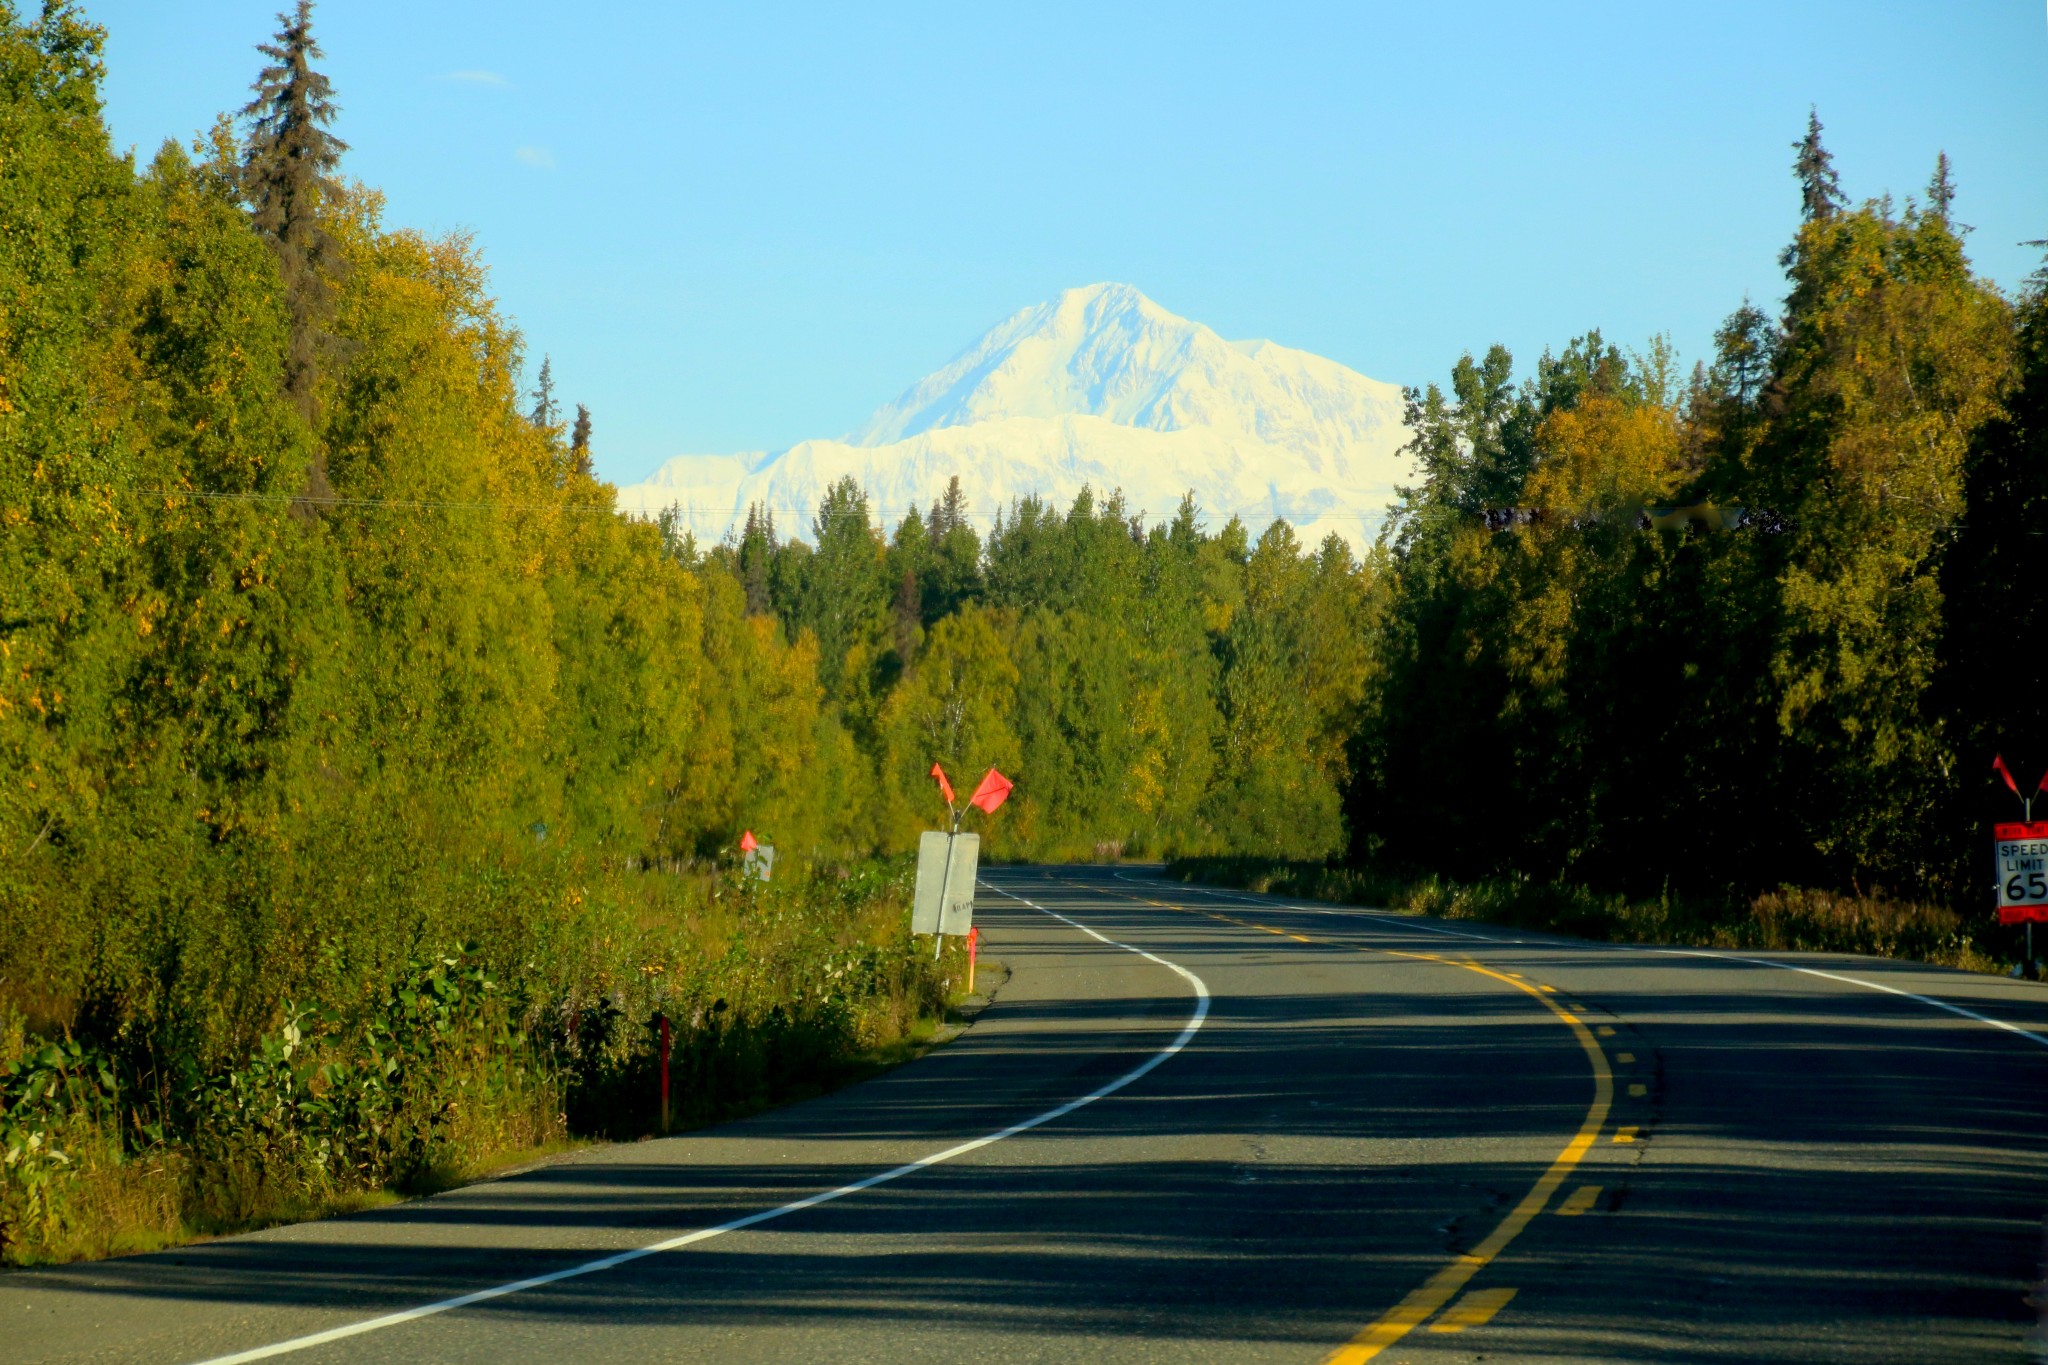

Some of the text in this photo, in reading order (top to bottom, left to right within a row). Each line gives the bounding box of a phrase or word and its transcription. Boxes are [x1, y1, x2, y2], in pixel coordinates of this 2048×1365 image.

[2001, 844, 2048, 857] SPEED
[2007, 859, 2044, 871] LIMIT
[2006, 873, 2047, 900] 65
